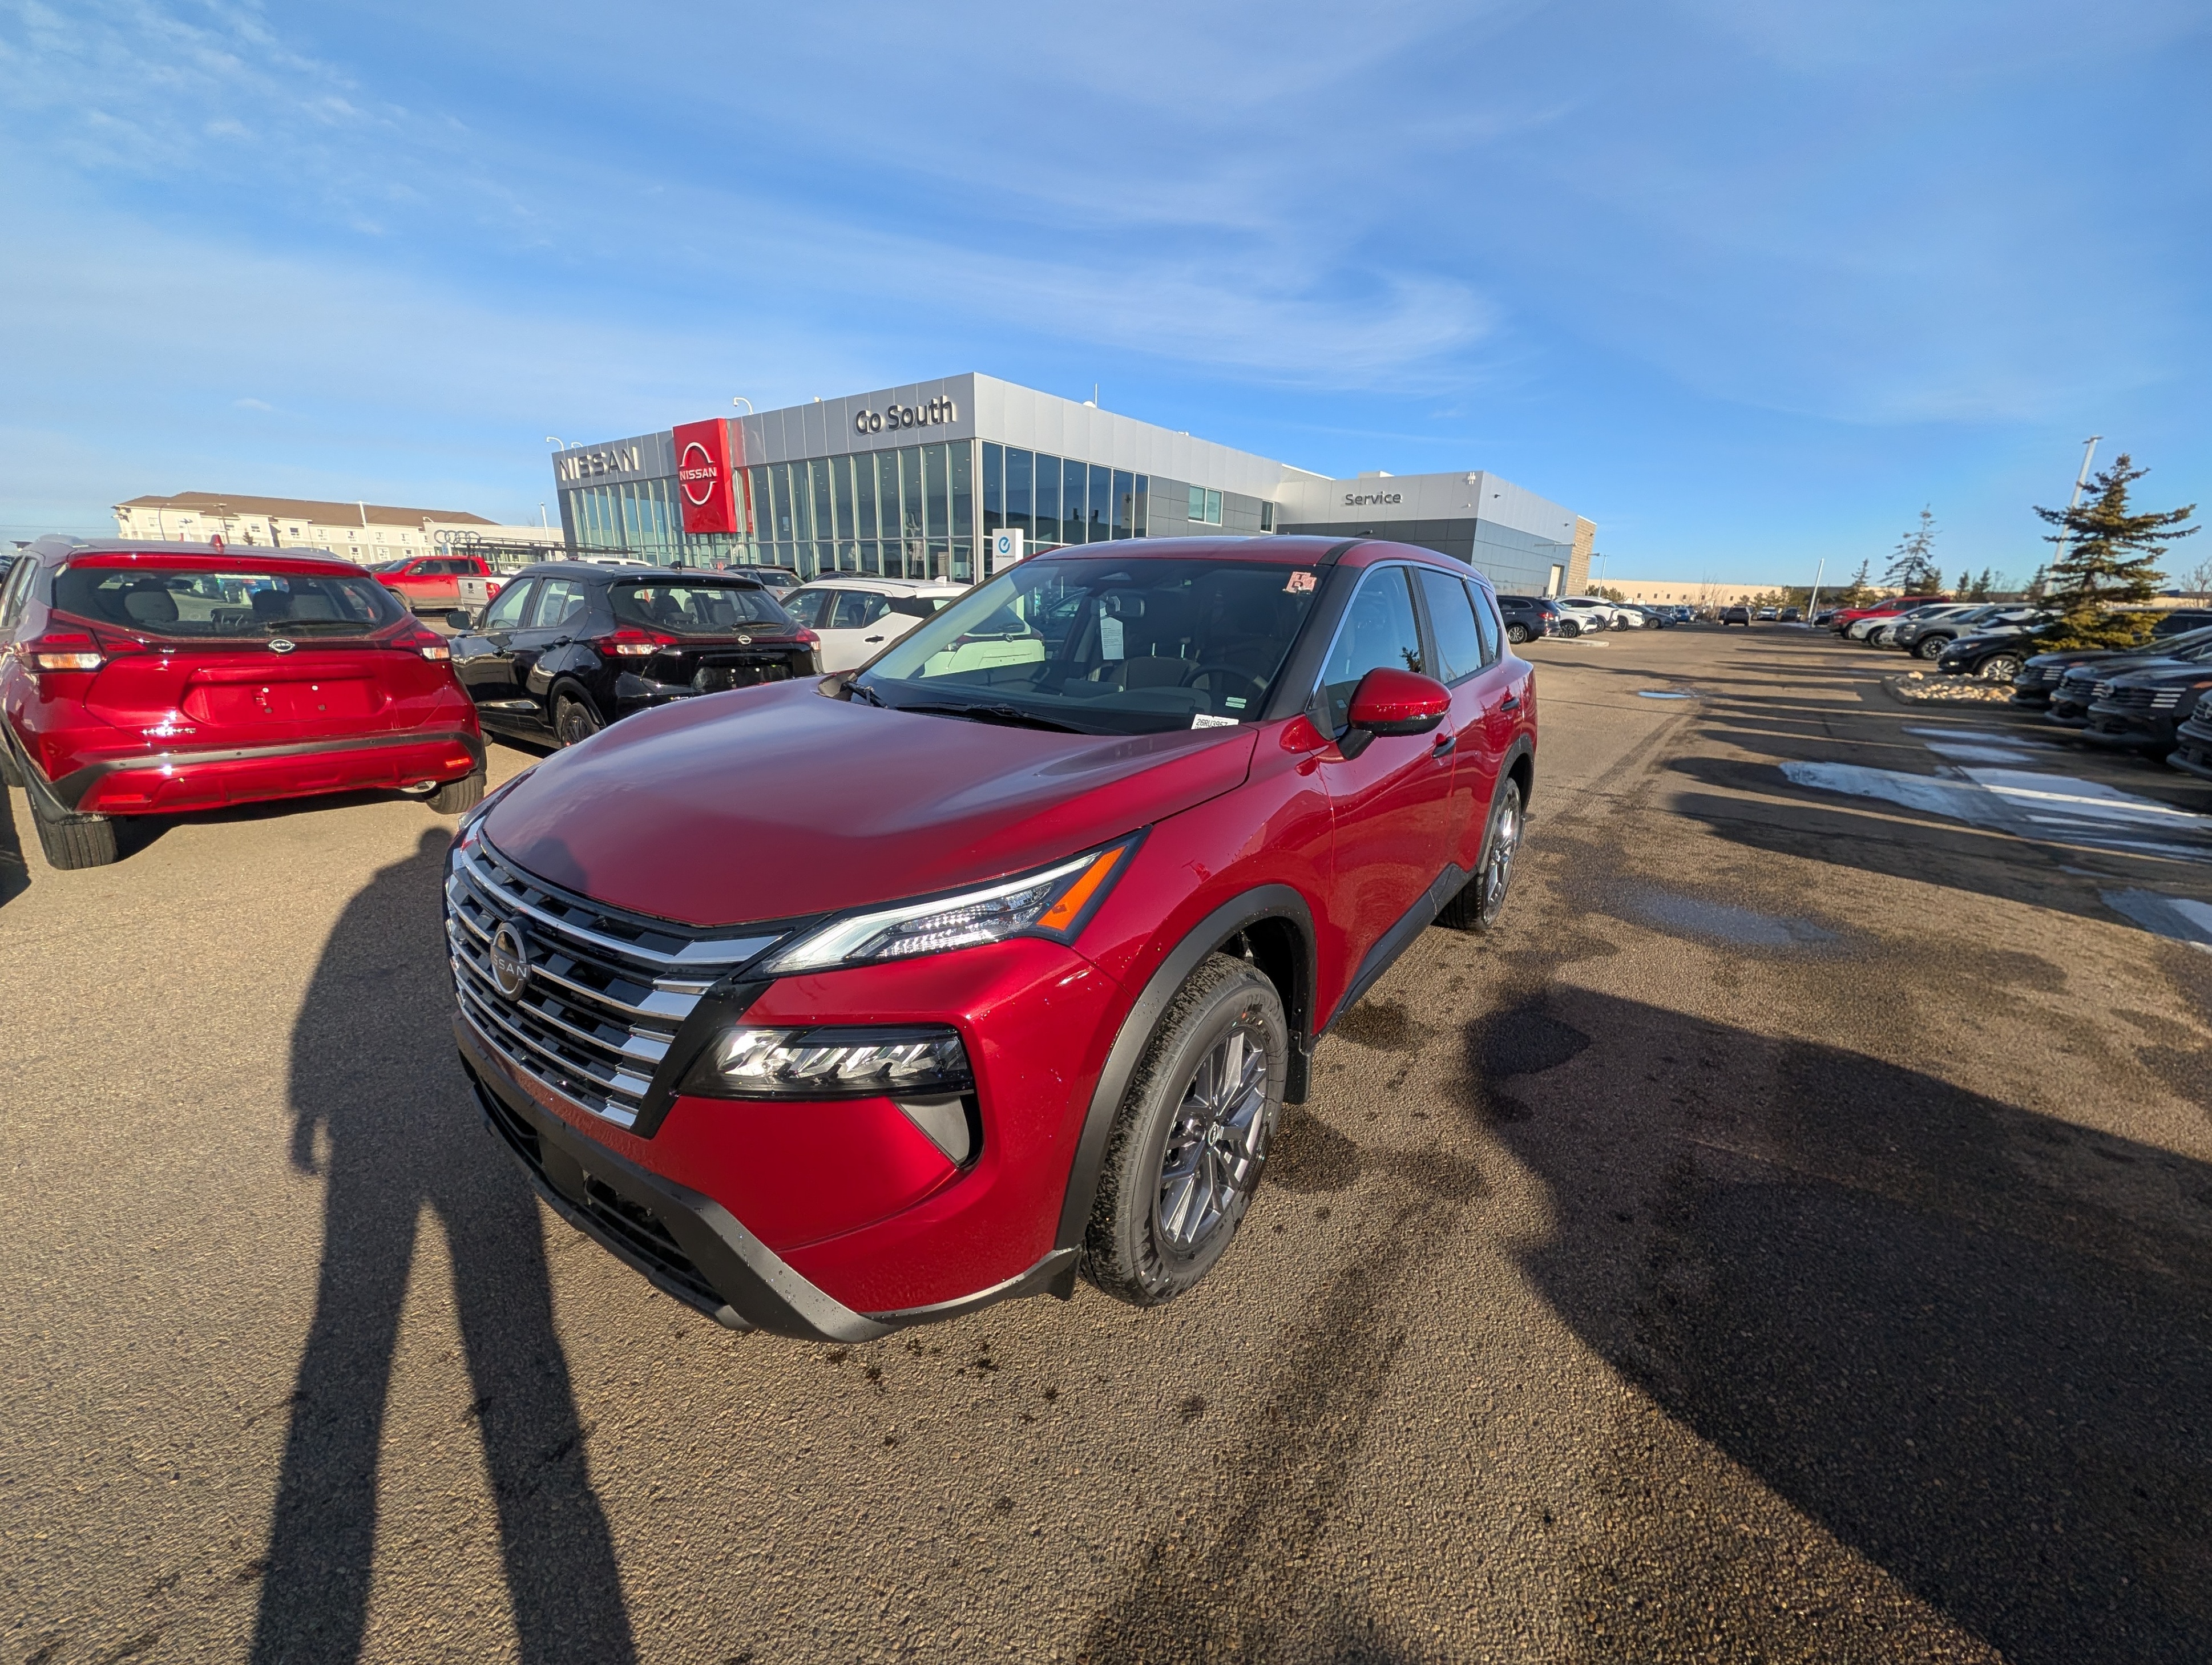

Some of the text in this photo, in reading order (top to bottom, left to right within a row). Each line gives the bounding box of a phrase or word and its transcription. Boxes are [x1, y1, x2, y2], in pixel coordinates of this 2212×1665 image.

[855, 395, 956, 434] Go South
[559, 446, 639, 481] NISSAN
[679, 467, 717, 481] NISSAN
[1345, 491, 1402, 506] Service
[493, 954, 527, 978] SSAN
